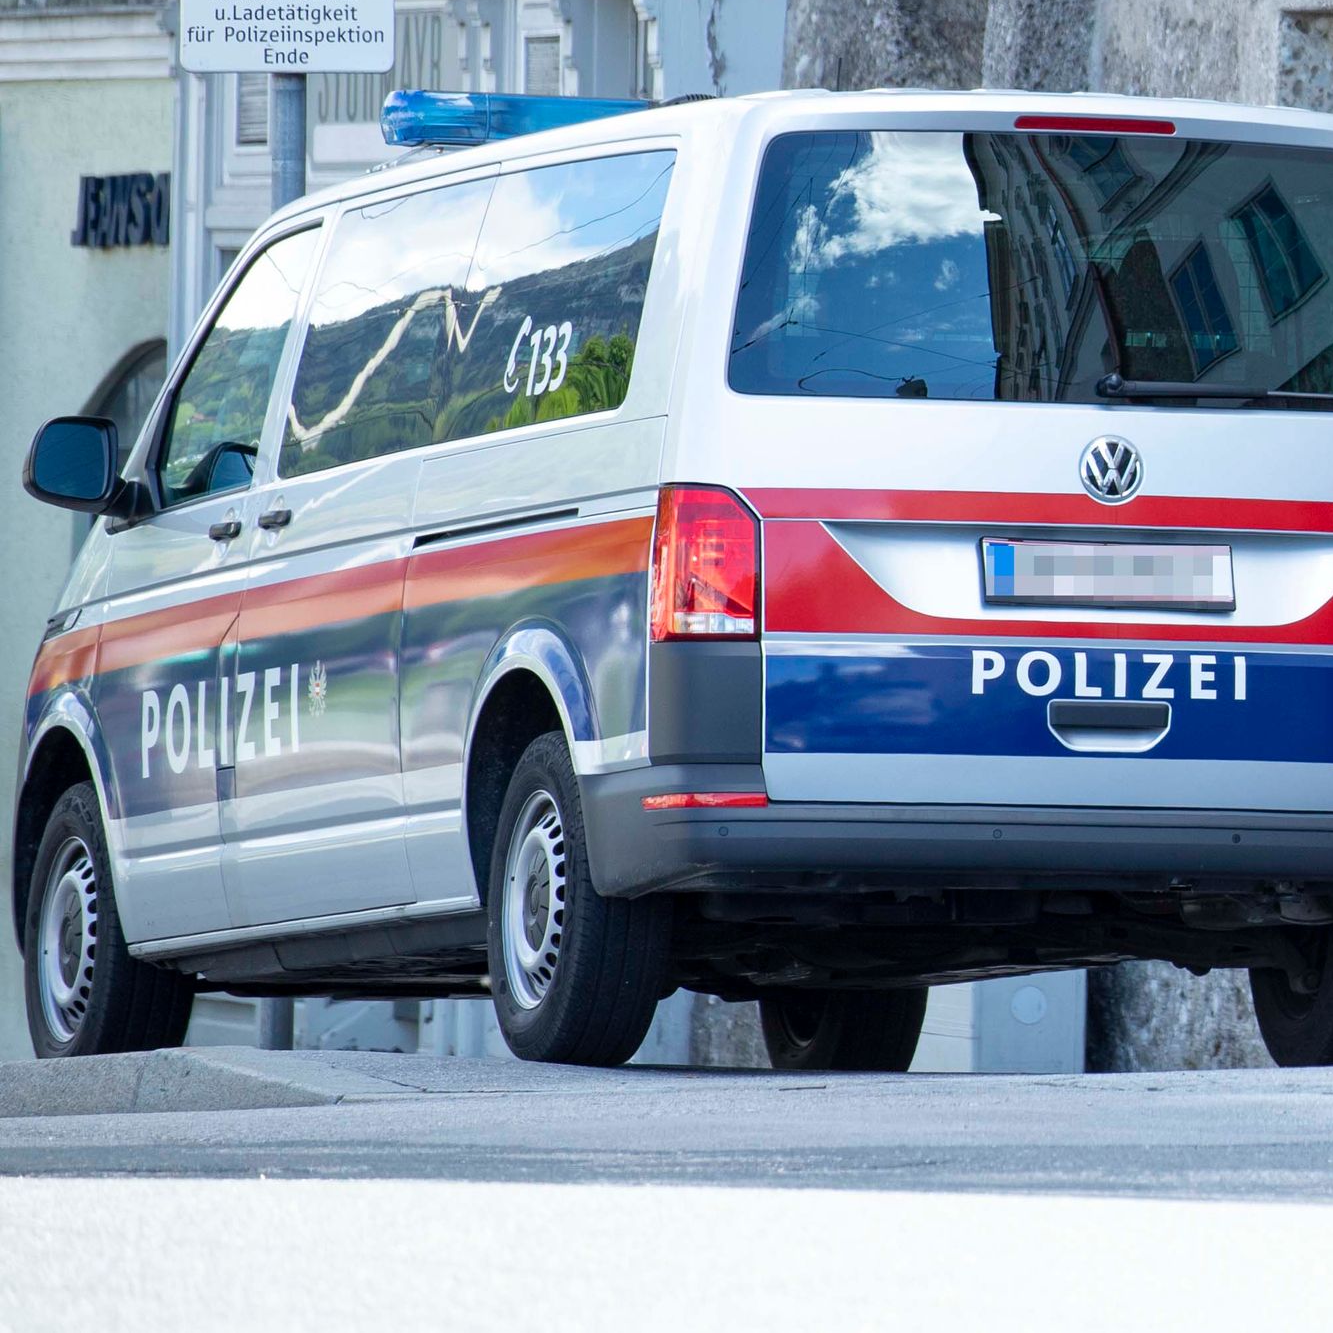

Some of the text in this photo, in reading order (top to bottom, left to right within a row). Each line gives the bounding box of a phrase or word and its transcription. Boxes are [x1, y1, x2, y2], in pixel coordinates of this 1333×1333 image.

[187, 27, 385, 46] für Polizeiinspektion
[215, 5, 358, 24] u.Ladetätigkeit
[264, 48, 309, 64] Ende
[526, 321, 573, 396] 133
[1080, 436, 1142, 503] VW
[971, 649, 1248, 701] POLIZEI
[141, 663, 300, 779] POLIZEI
